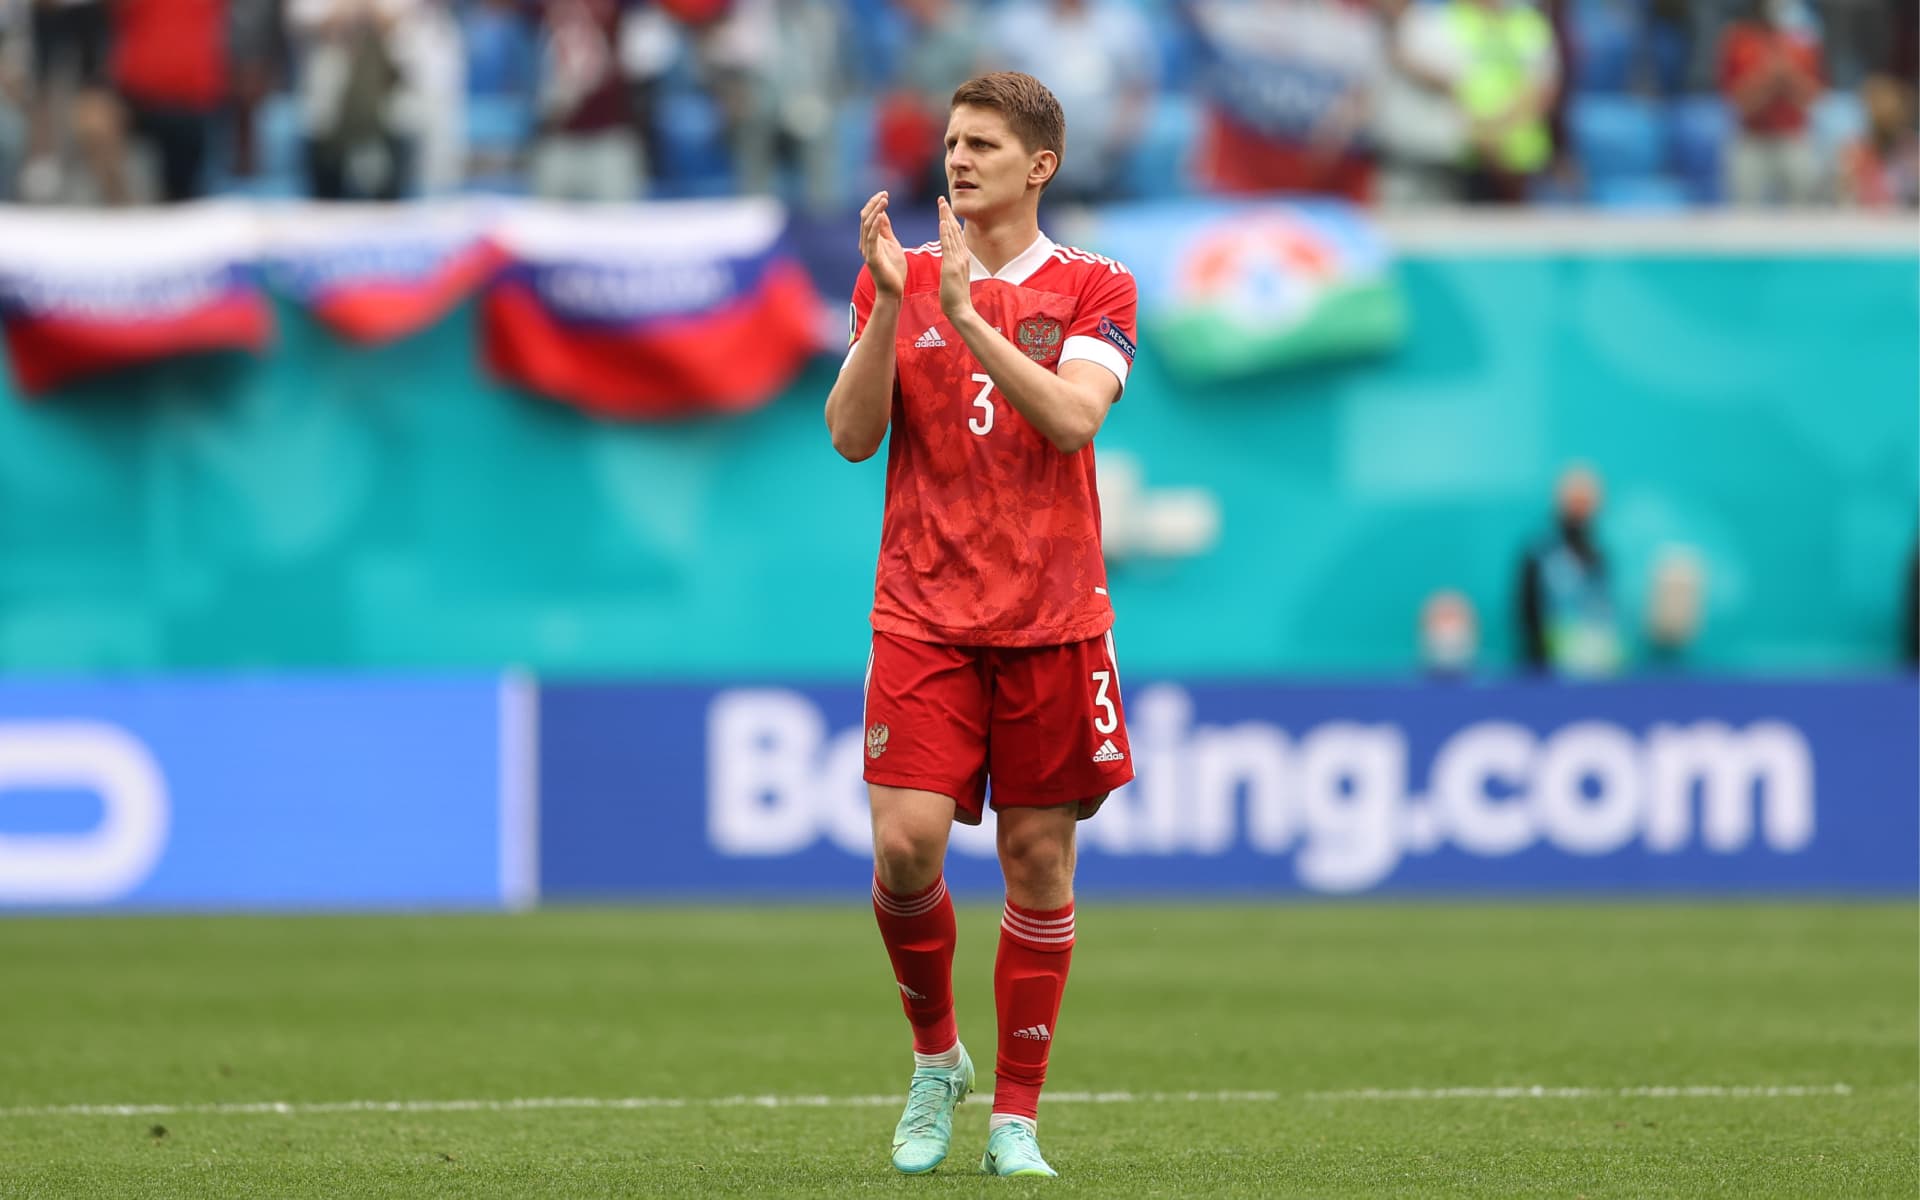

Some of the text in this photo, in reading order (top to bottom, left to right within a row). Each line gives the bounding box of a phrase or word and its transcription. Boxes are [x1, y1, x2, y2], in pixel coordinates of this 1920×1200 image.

[914, 339, 946, 348] adidas
[1109, 328, 1136, 356] RESPECT
[968, 373, 995, 436] 3
[1092, 671, 1118, 734] 3
[1092, 752, 1124, 762] adidas
[709, 686, 1813, 891] Bing.com
[1013, 1031, 1051, 1041] adida
